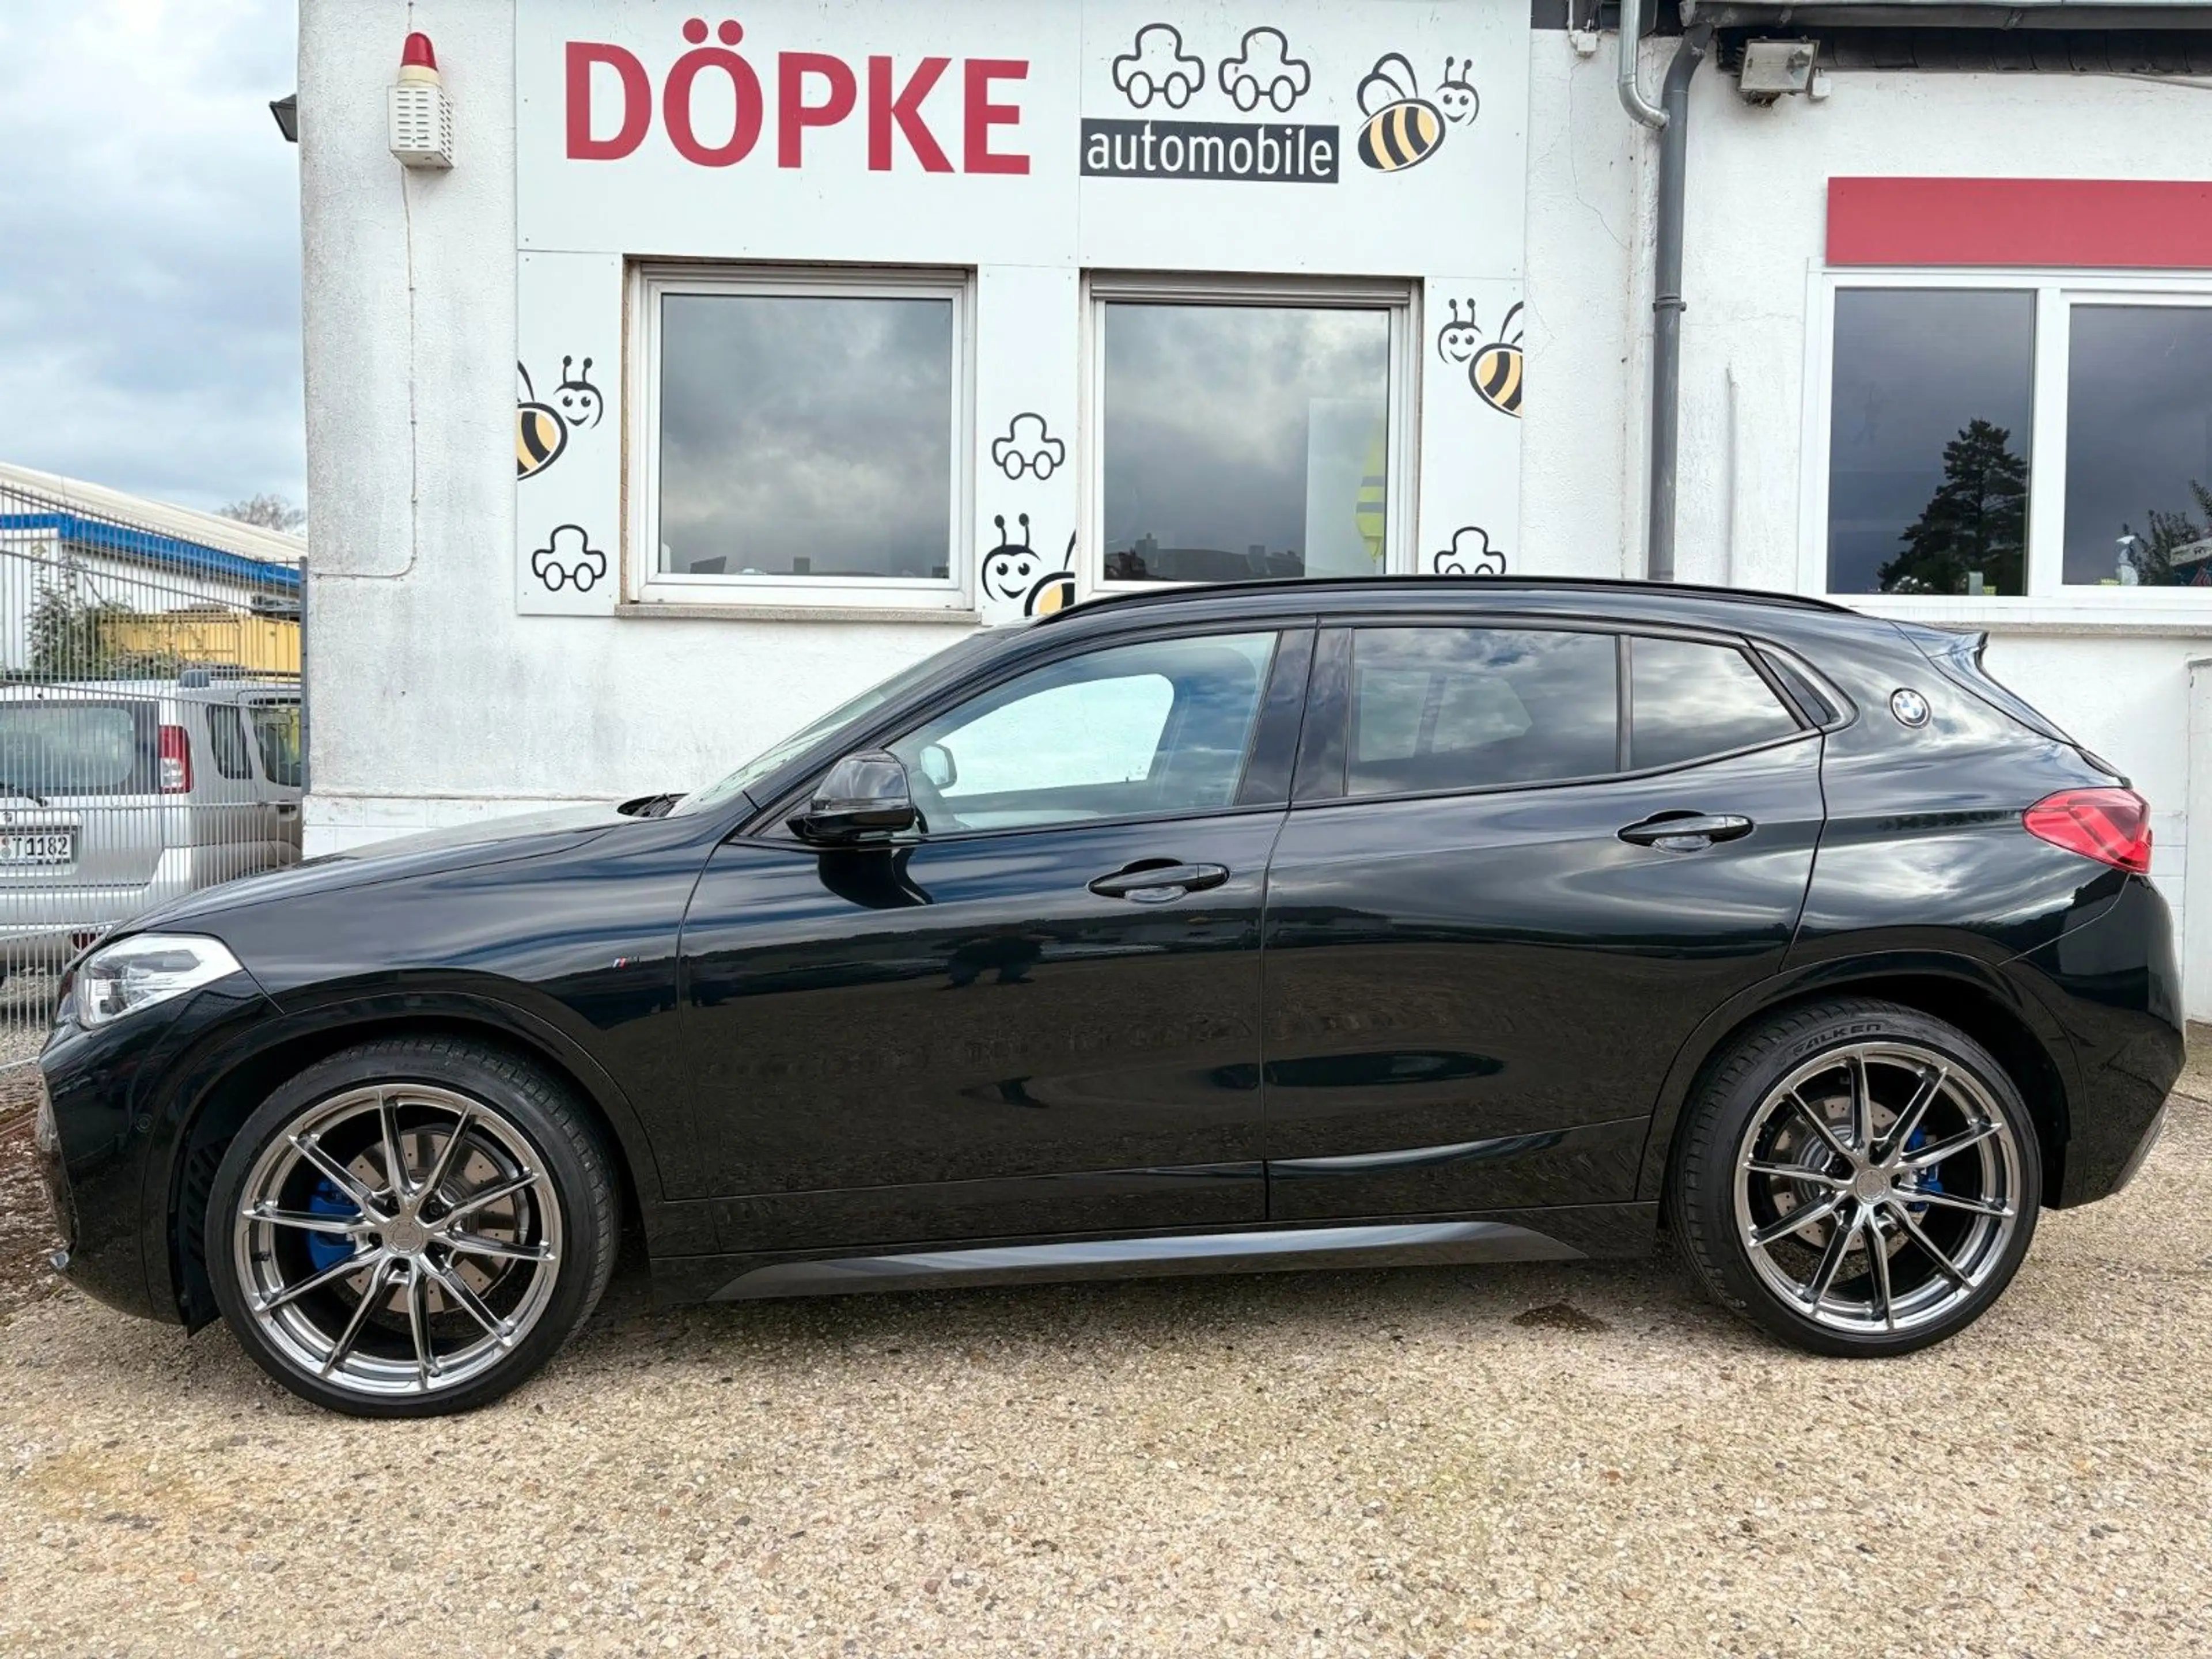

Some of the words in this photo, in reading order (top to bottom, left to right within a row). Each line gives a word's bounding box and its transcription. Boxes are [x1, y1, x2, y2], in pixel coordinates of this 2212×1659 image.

[567, 19, 1030, 175] DÖPKE
[1087, 122, 1332, 176] automobile
[26, 836, 68, 855] 1182
[1793, 1024, 1881, 1056] FALKEN
